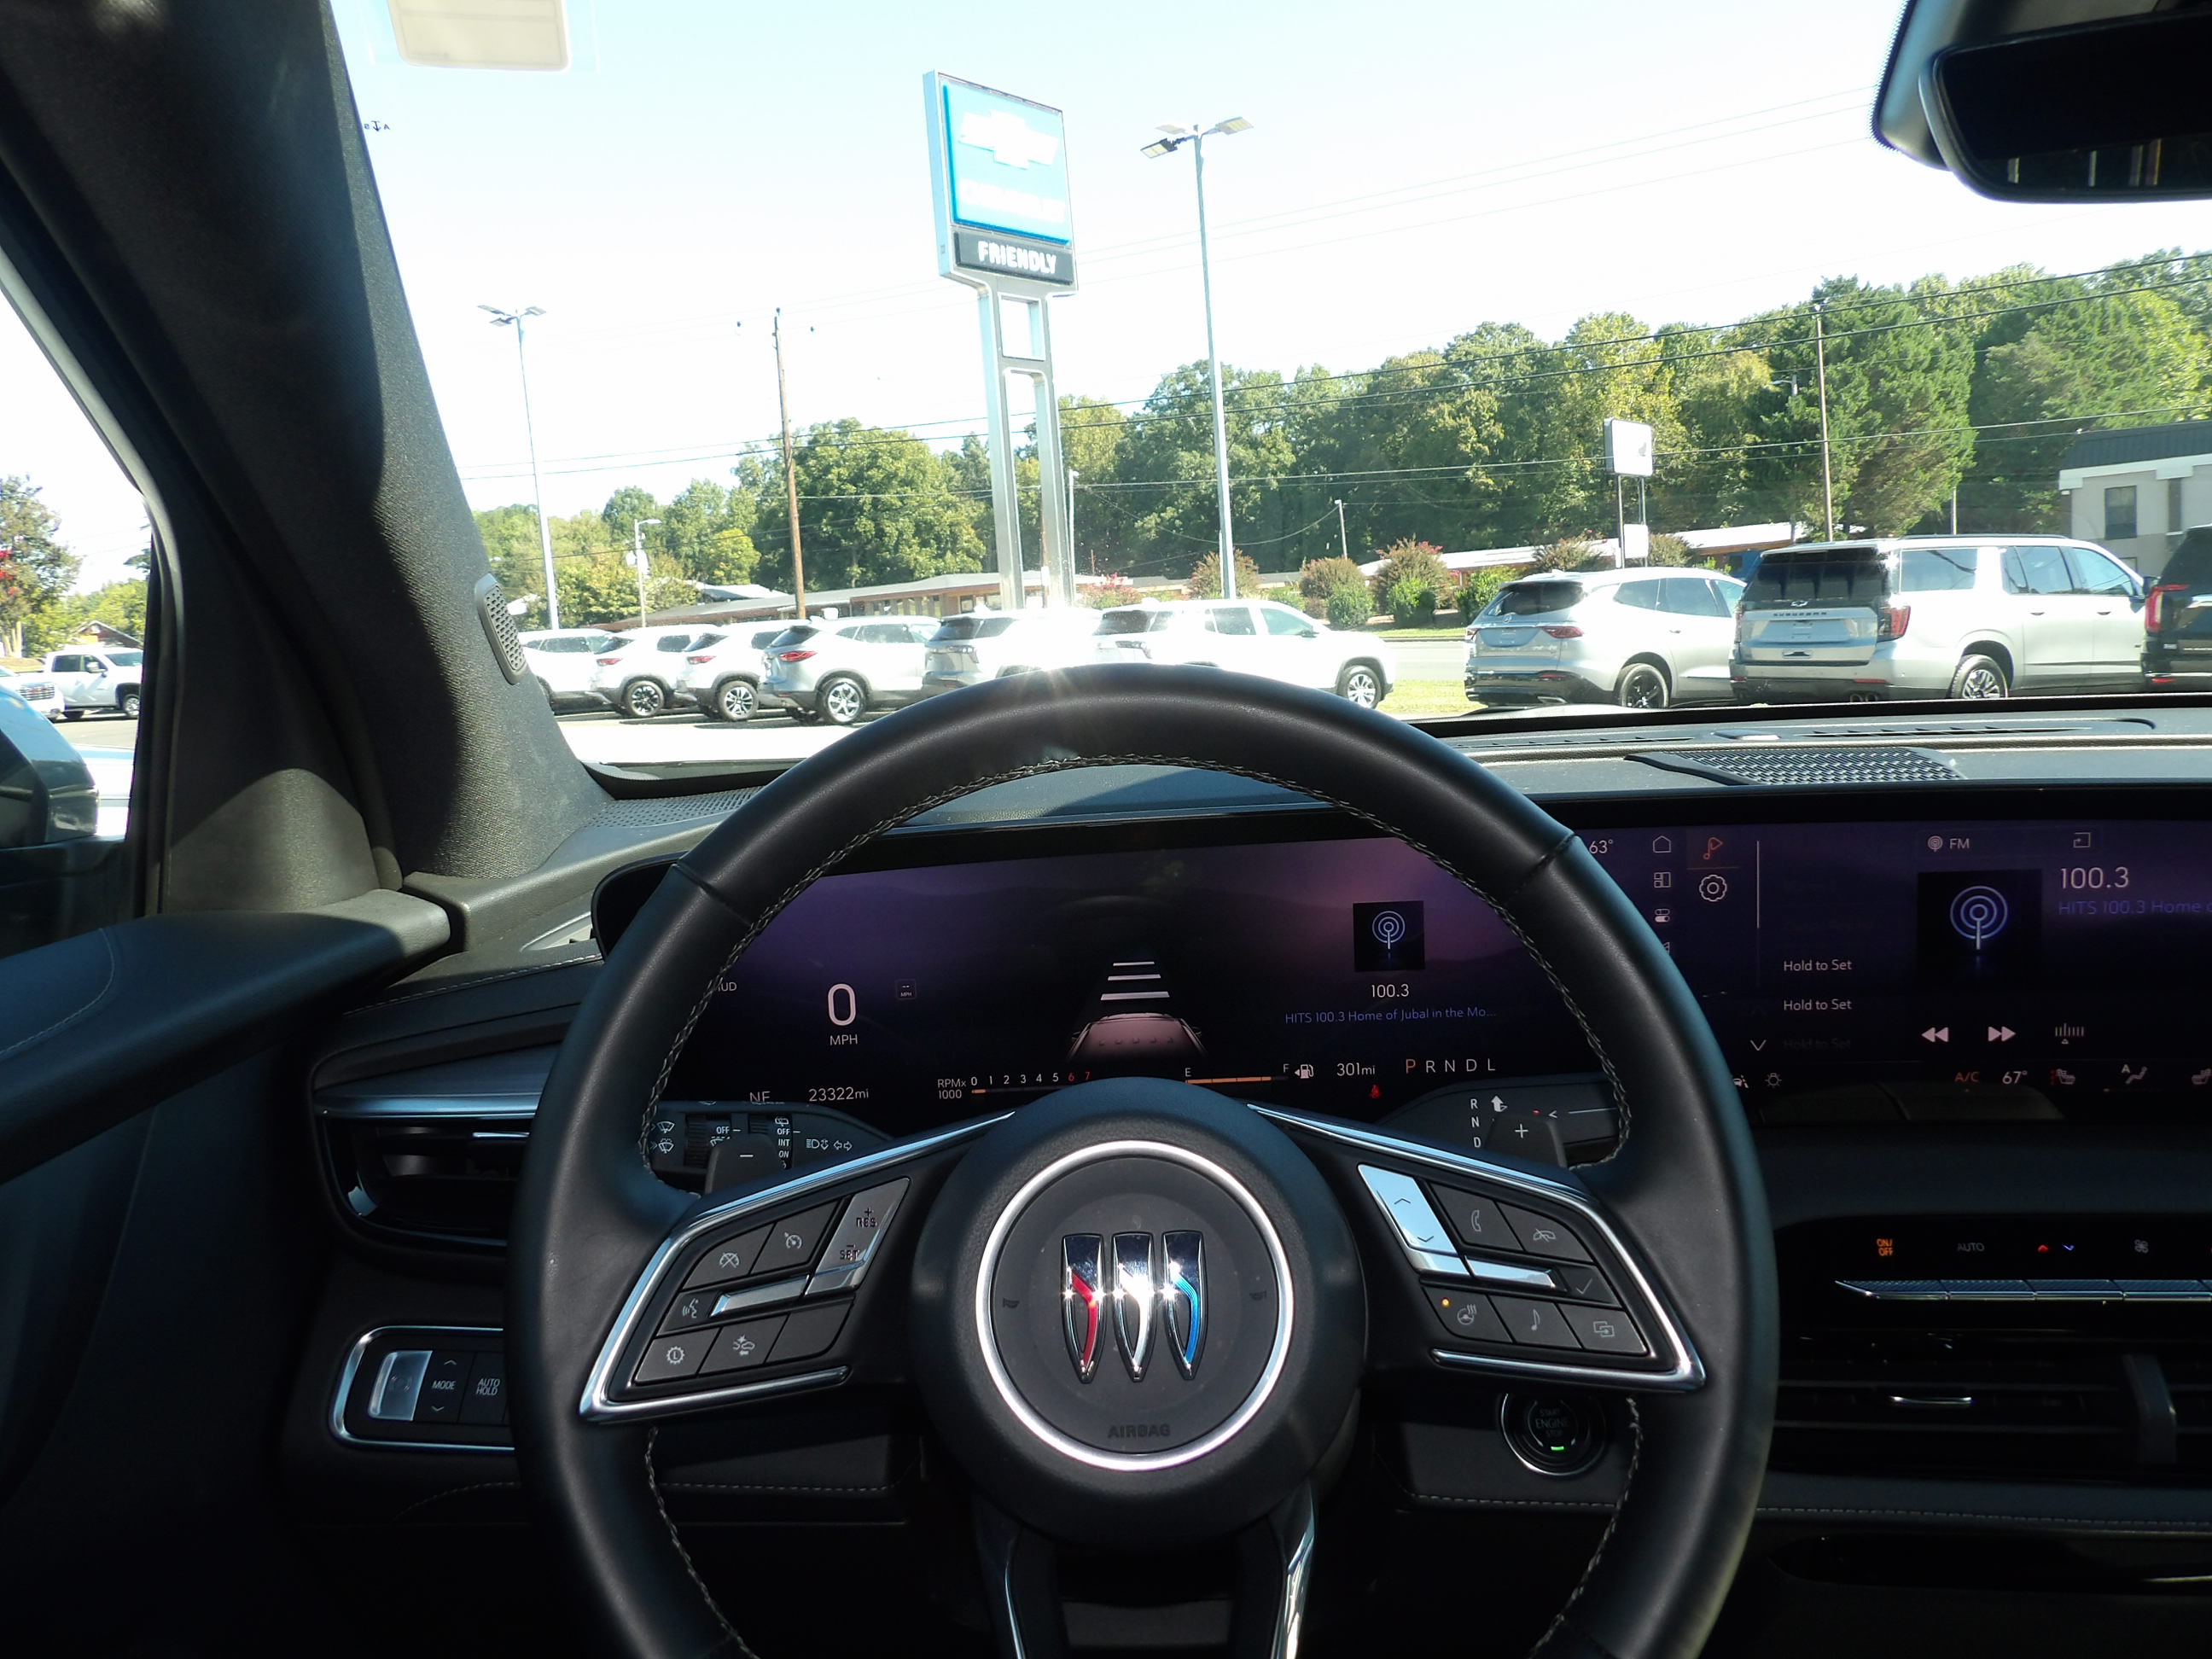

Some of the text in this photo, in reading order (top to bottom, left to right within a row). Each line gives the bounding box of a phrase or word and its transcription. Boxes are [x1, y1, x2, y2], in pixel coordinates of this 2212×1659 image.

[977, 240, 1057, 274] FRIENDLY
[1589, 839, 1614, 854] 63°
[1949, 838, 1970, 849] FM
[2060, 867, 2130, 889] 100.3
[2058, 901, 2097, 915] HITS
[2103, 900, 2146, 914] 100.3
[2151, 900, 2201, 913] Home
[1784, 959, 1853, 971] Hold to Set
[719, 981, 737, 992] UD
[1371, 984, 1410, 998] 100.3
[827, 983, 857, 1026] 0
[1784, 998, 1853, 1010] Hold to Set
[1285, 1013, 1313, 1023] HITS
[1315, 1011, 1345, 1022] 100.3
[1348, 1010, 1382, 1021] Home
[1385, 1009, 1399, 1020] of
[1400, 1008, 1429, 1020] Jubal
[1432, 1008, 1442, 1018] in
[1445, 1008, 1464, 1017] the
[830, 1034, 859, 1045] MPH
[1185, 1068, 1191, 1077] E
[1283, 1064, 1289, 1073] F
[1336, 1062, 1376, 1076] 301mi
[970, 1076, 978, 1086] 0
[988, 1075, 993, 1085] 1
[1004, 1075, 1010, 1085] 2
[1020, 1074, 1027, 1084] 3
[1035, 1074, 1042, 1083] 4
[1052, 1073, 1059, 1082] 5
[1085, 1071, 1091, 1080] 7
[1954, 1071, 1979, 1082] A/C
[2001, 1070, 2028, 1084] 67°
[938, 1079, 967, 1088] RPMx
[808, 1086, 870, 1102] 23322mi
[939, 1089, 963, 1099] 1000
[1470, 1098, 1478, 1109] R
[1471, 1116, 1480, 1127] N
[716, 1126, 731, 1135] OFF
[777, 1127, 790, 1136] OFF
[777, 1138, 790, 1147] INT
[1473, 1136, 1481, 1148] D
[778, 1150, 789, 1159] ON
[856, 1217, 876, 1227] RES
[1878, 1248, 1895, 1256] OFF
[1957, 1243, 1985, 1252] AUTO
[840, 1249, 859, 1260] SET
[432, 1380, 457, 1390] MODE
[478, 1378, 501, 1387] AUTO
[475, 1386, 498, 1395] HOLD
[1108, 1423, 1171, 1439] AIRBAG
